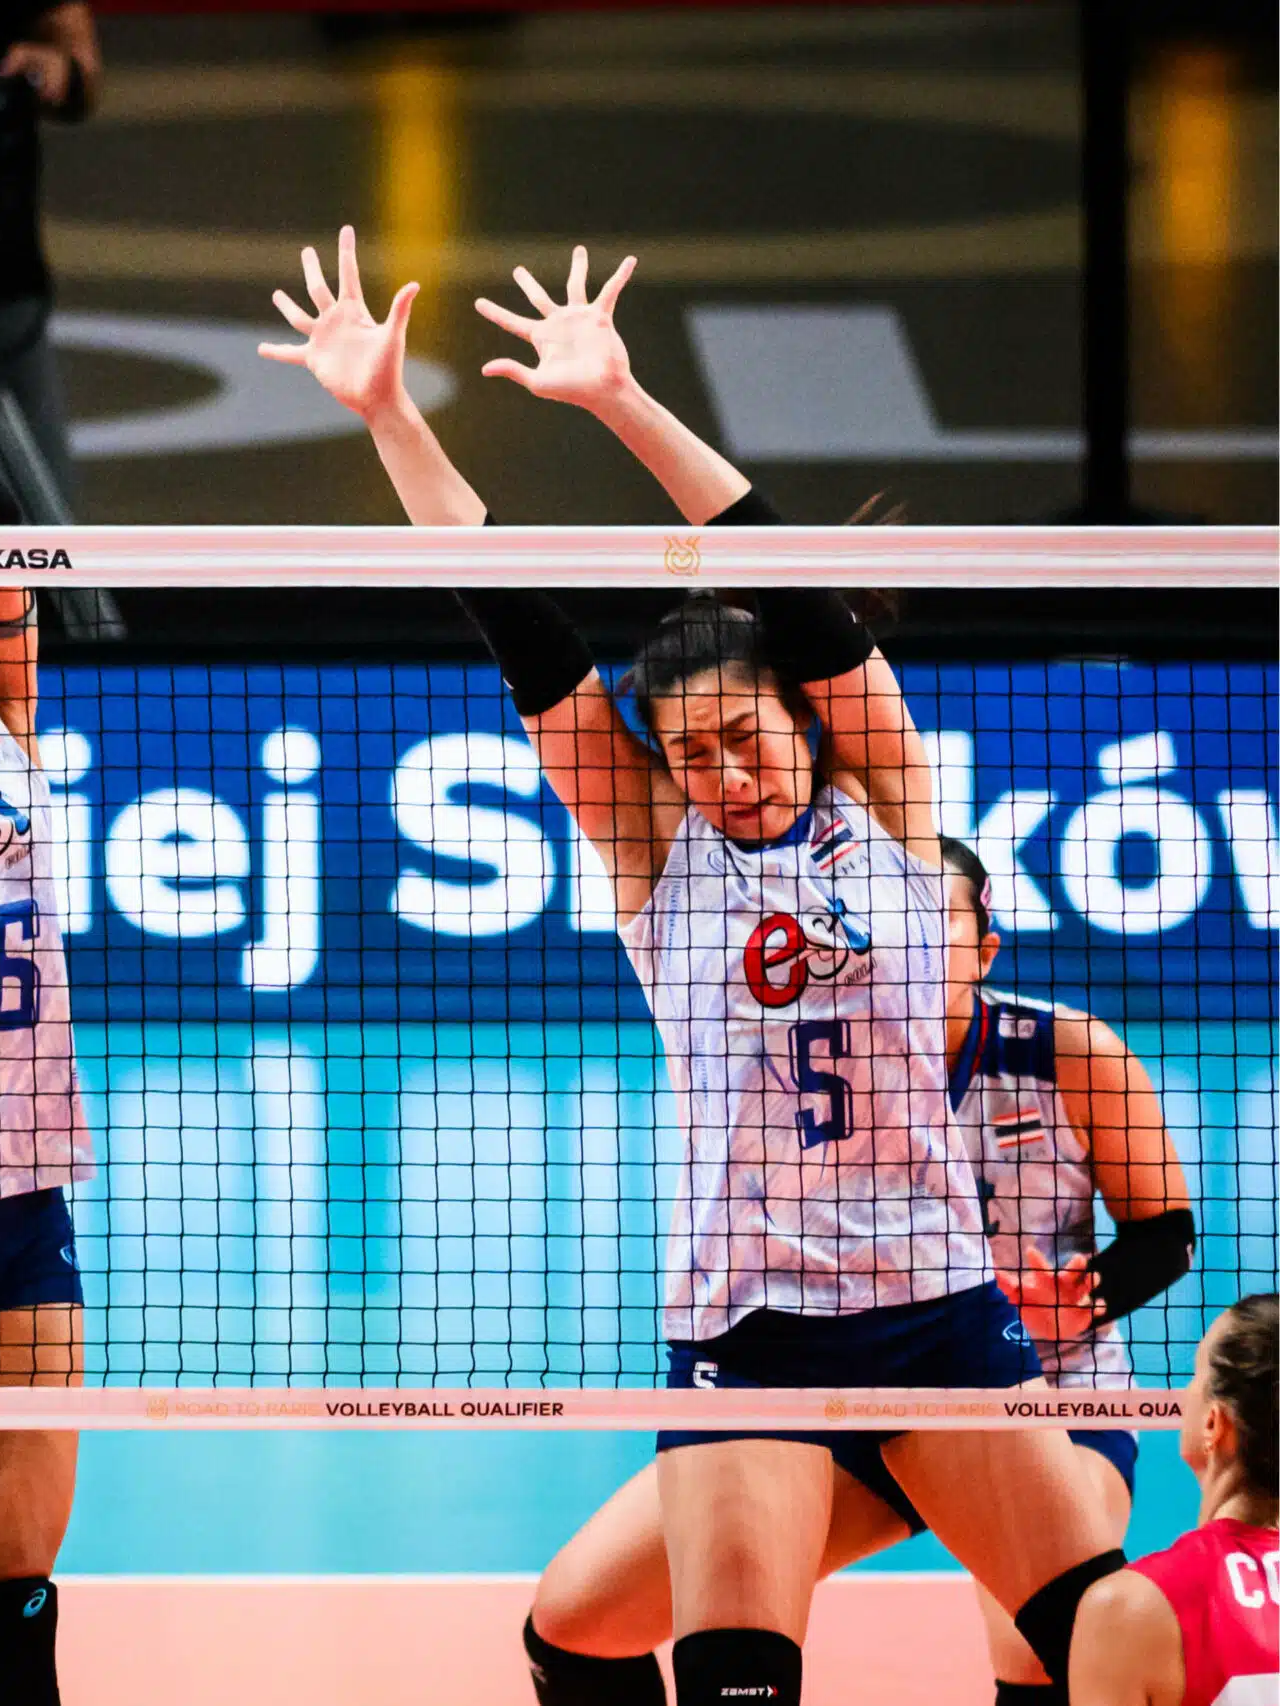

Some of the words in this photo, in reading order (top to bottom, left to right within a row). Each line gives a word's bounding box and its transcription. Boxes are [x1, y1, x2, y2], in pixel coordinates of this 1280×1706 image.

[787, 1019, 854, 1150] 5
[325, 1402, 455, 1417] VOLLEYBALL
[460, 1402, 564, 1417] QUALIFIER
[1004, 1402, 1133, 1417] VOLLEYBALL
[1139, 1402, 1182, 1417] QUA
